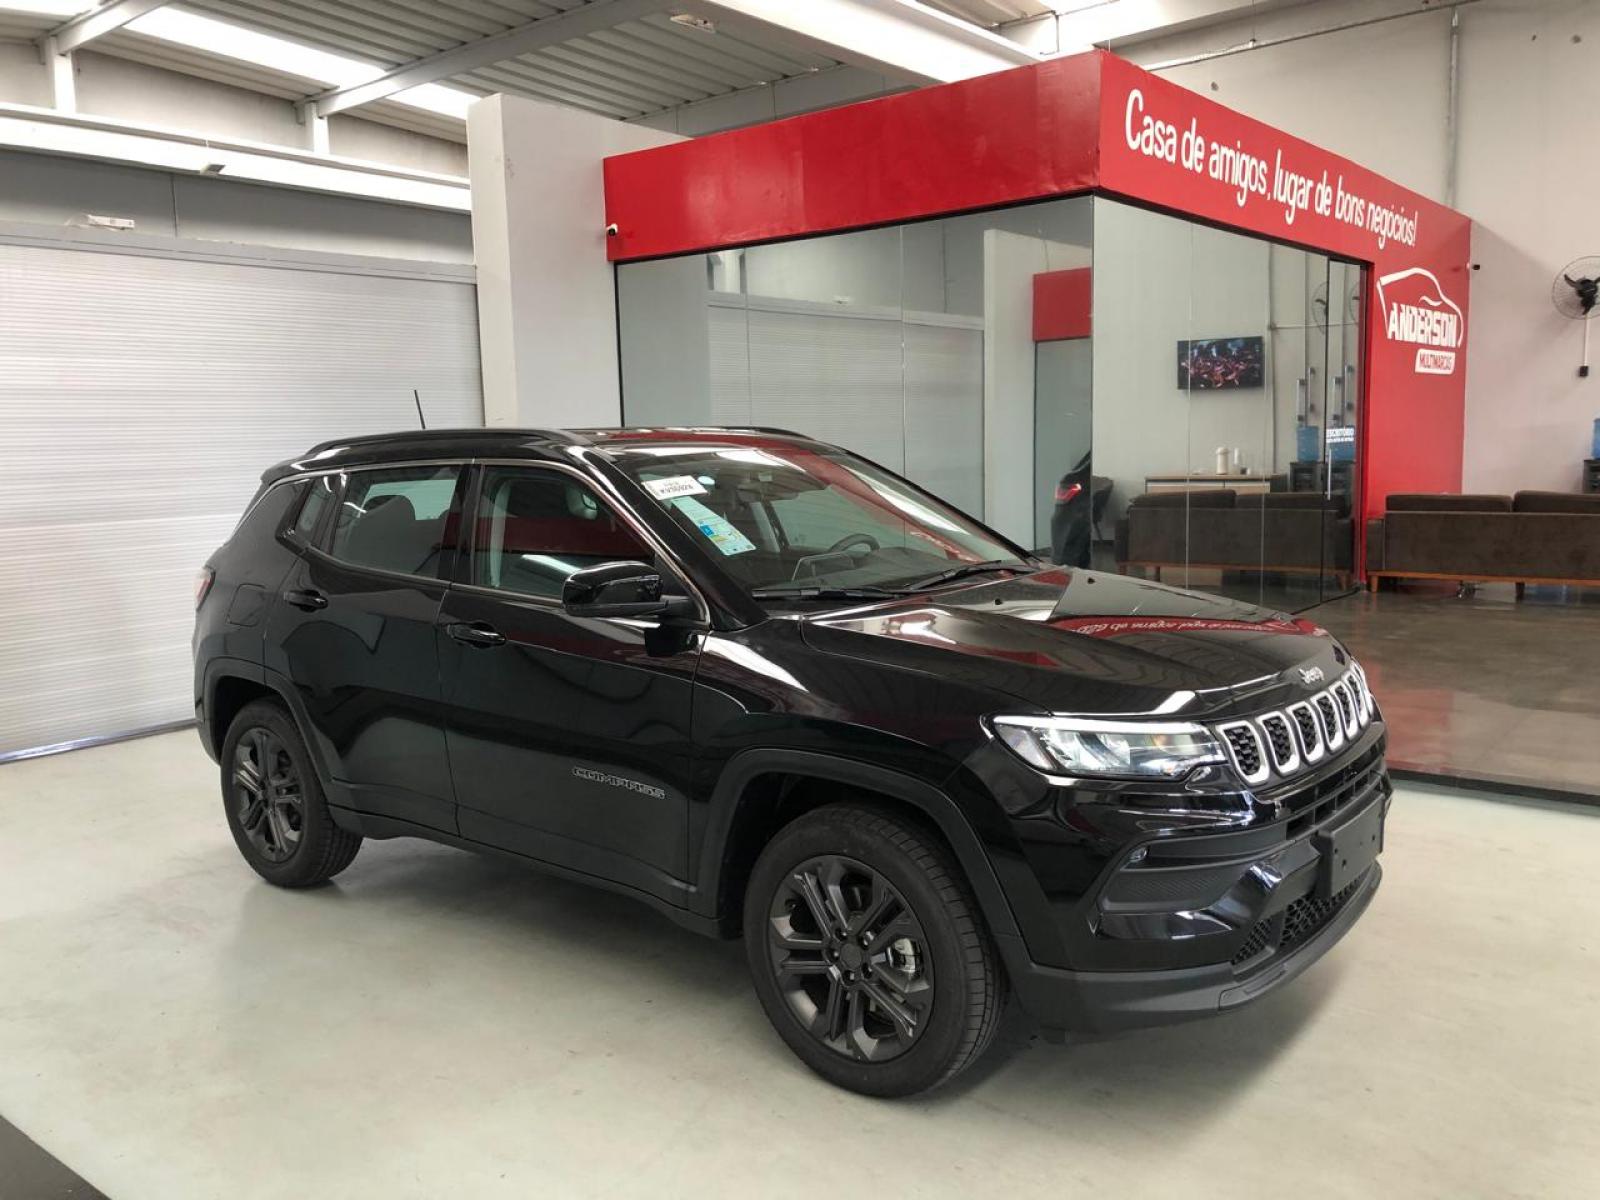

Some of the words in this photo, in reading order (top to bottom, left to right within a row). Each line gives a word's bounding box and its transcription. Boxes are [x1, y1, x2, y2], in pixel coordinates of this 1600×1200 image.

[1125, 88, 1177, 164] Casa
[1181, 117, 1205, 173] de
[1208, 140, 1271, 207] amigos,
[1273, 148, 1314, 225] lugar
[1314, 170, 1333, 217] de
[1334, 174, 1365, 228] bons
[1365, 204, 1418, 250] negócios!
[1387, 302, 1457, 348] ANDERSON
[1298, 666, 1325, 684] Jeep
[572, 766, 665, 799] COMPASS
